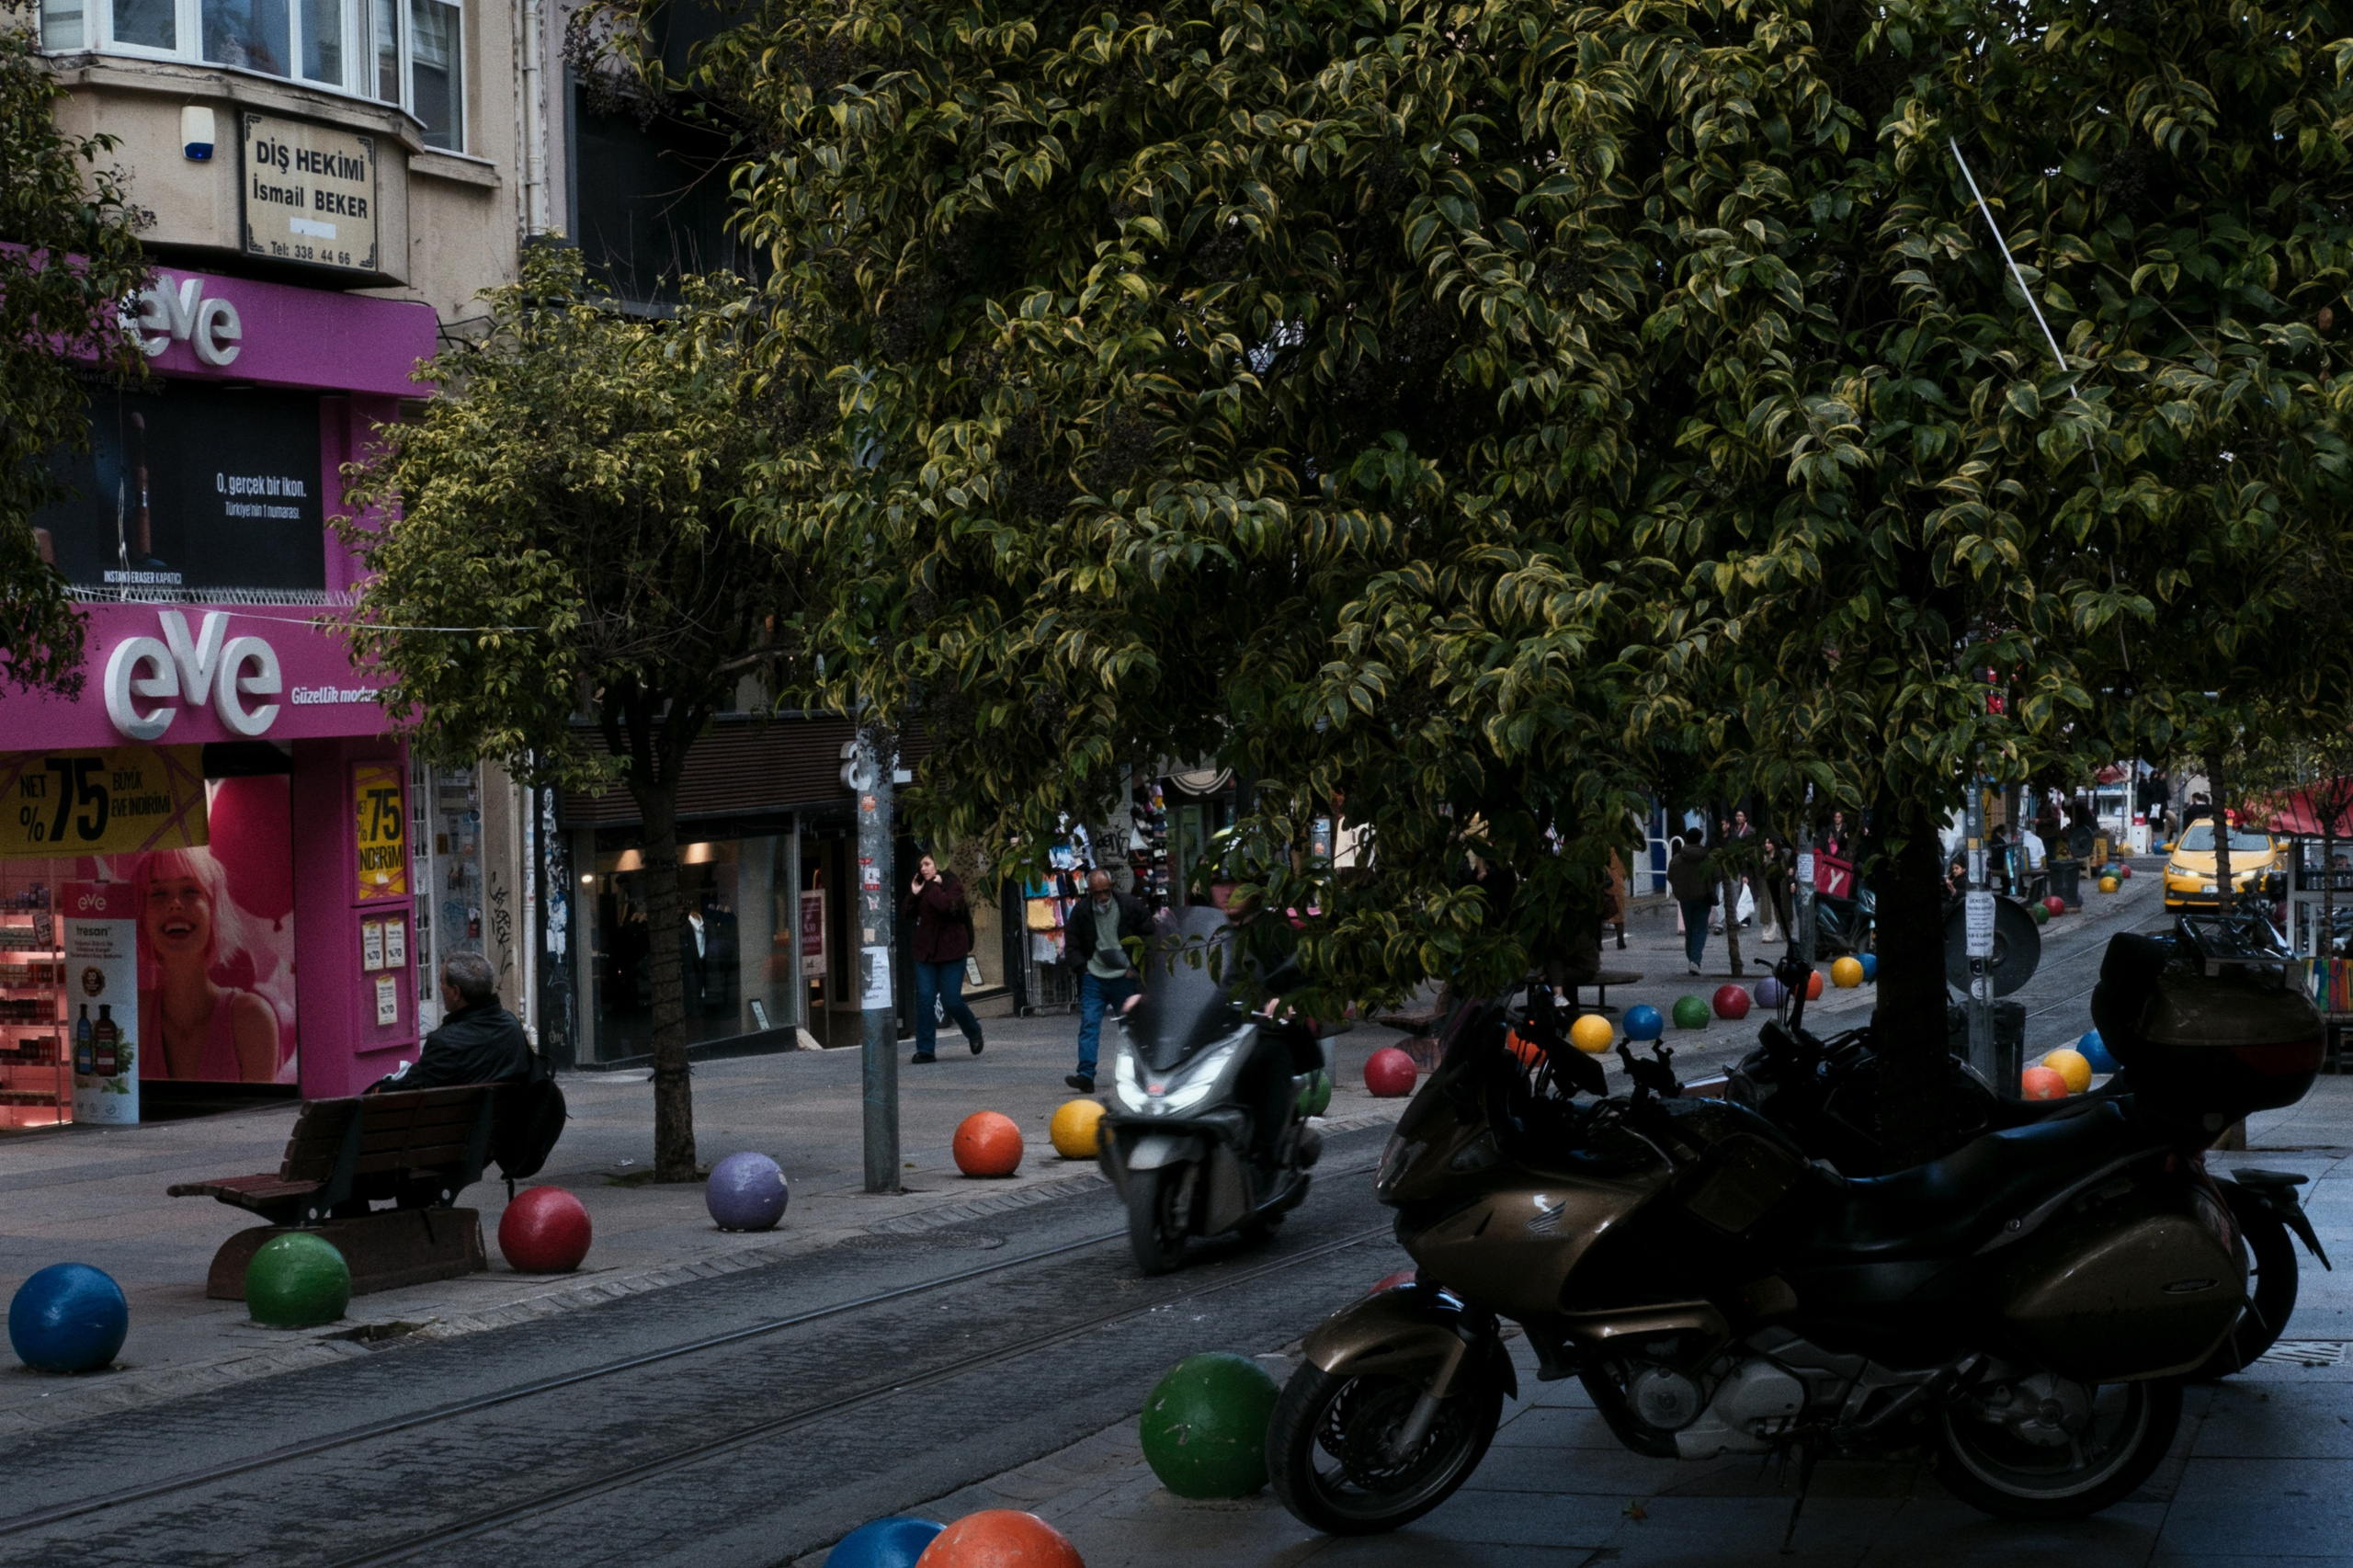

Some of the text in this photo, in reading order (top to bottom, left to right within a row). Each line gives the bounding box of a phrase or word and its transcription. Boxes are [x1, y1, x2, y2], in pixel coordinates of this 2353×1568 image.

[256, 137, 365, 182] DİŞ HEKİMİ
[253, 173, 368, 219] İsmail BEKER
[271, 241, 350, 265] Tel: 338 44 66
[216, 472, 307, 497] O, gerçek bir ikon.
[225, 501, 262, 517] Türkiye'nin
[263, 504, 267, 517] 1
[104, 570, 182, 585] INSTANT ERASER KAPATICI
[291, 686, 339, 705] Güzellik
[20, 775, 47, 798] NET
[113, 767, 143, 791] BÜYÜK
[111, 790, 171, 817] EVE İNDİRİMİ
